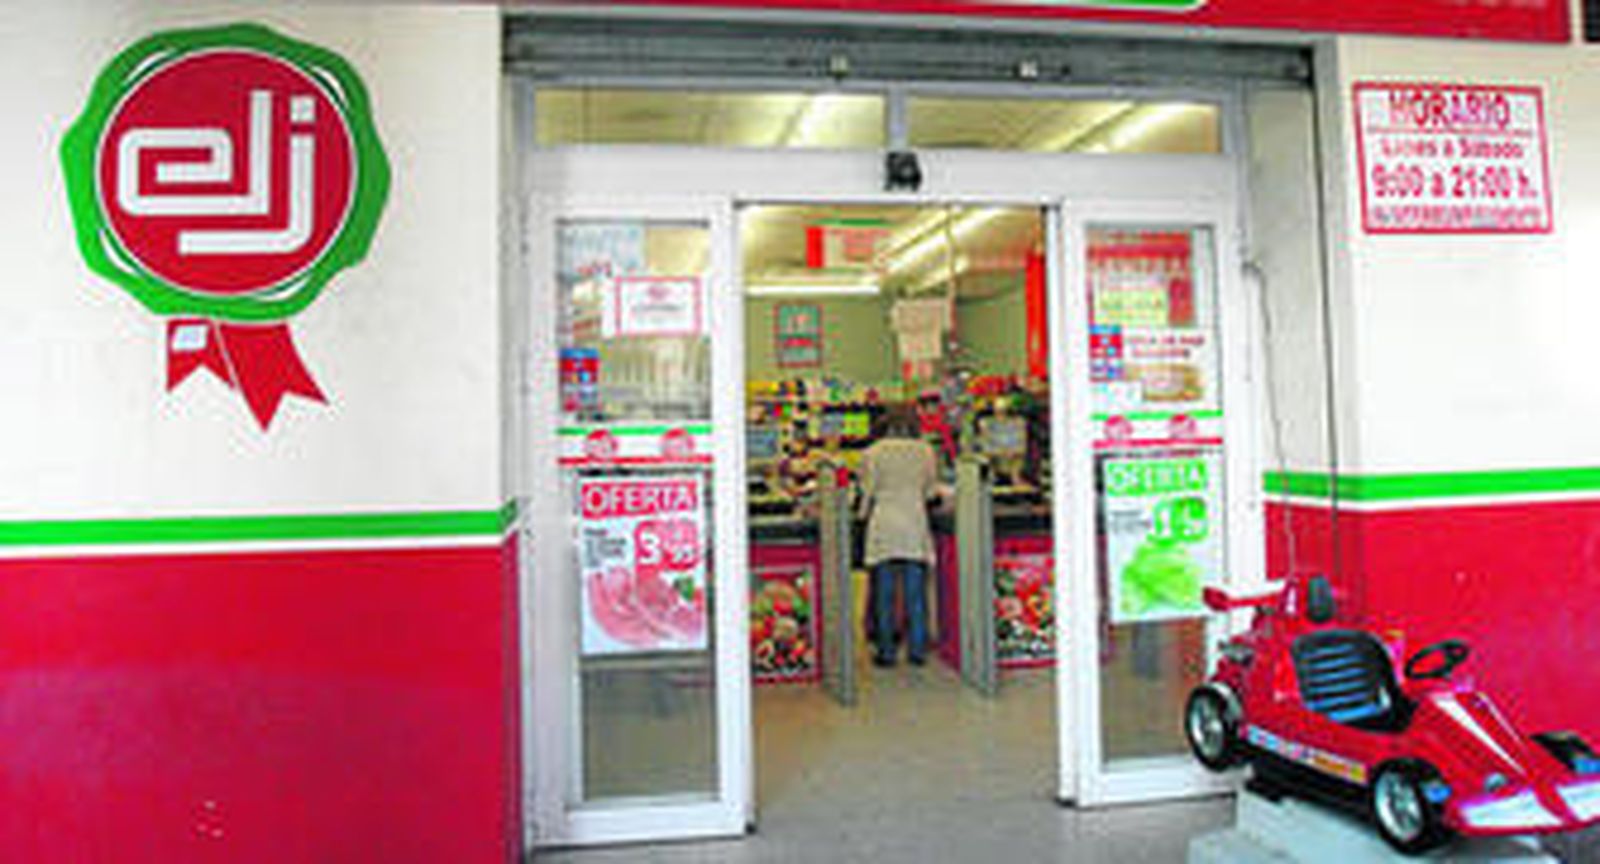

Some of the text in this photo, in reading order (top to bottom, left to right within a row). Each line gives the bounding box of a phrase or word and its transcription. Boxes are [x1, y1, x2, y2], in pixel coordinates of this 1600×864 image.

[1388, 90, 1511, 129] HORARIO
[1371, 164, 1424, 198] 9:00
[1431, 171, 1445, 198] a
[1450, 164, 1512, 198] 21:00
[584, 483, 696, 516] OFERTA
